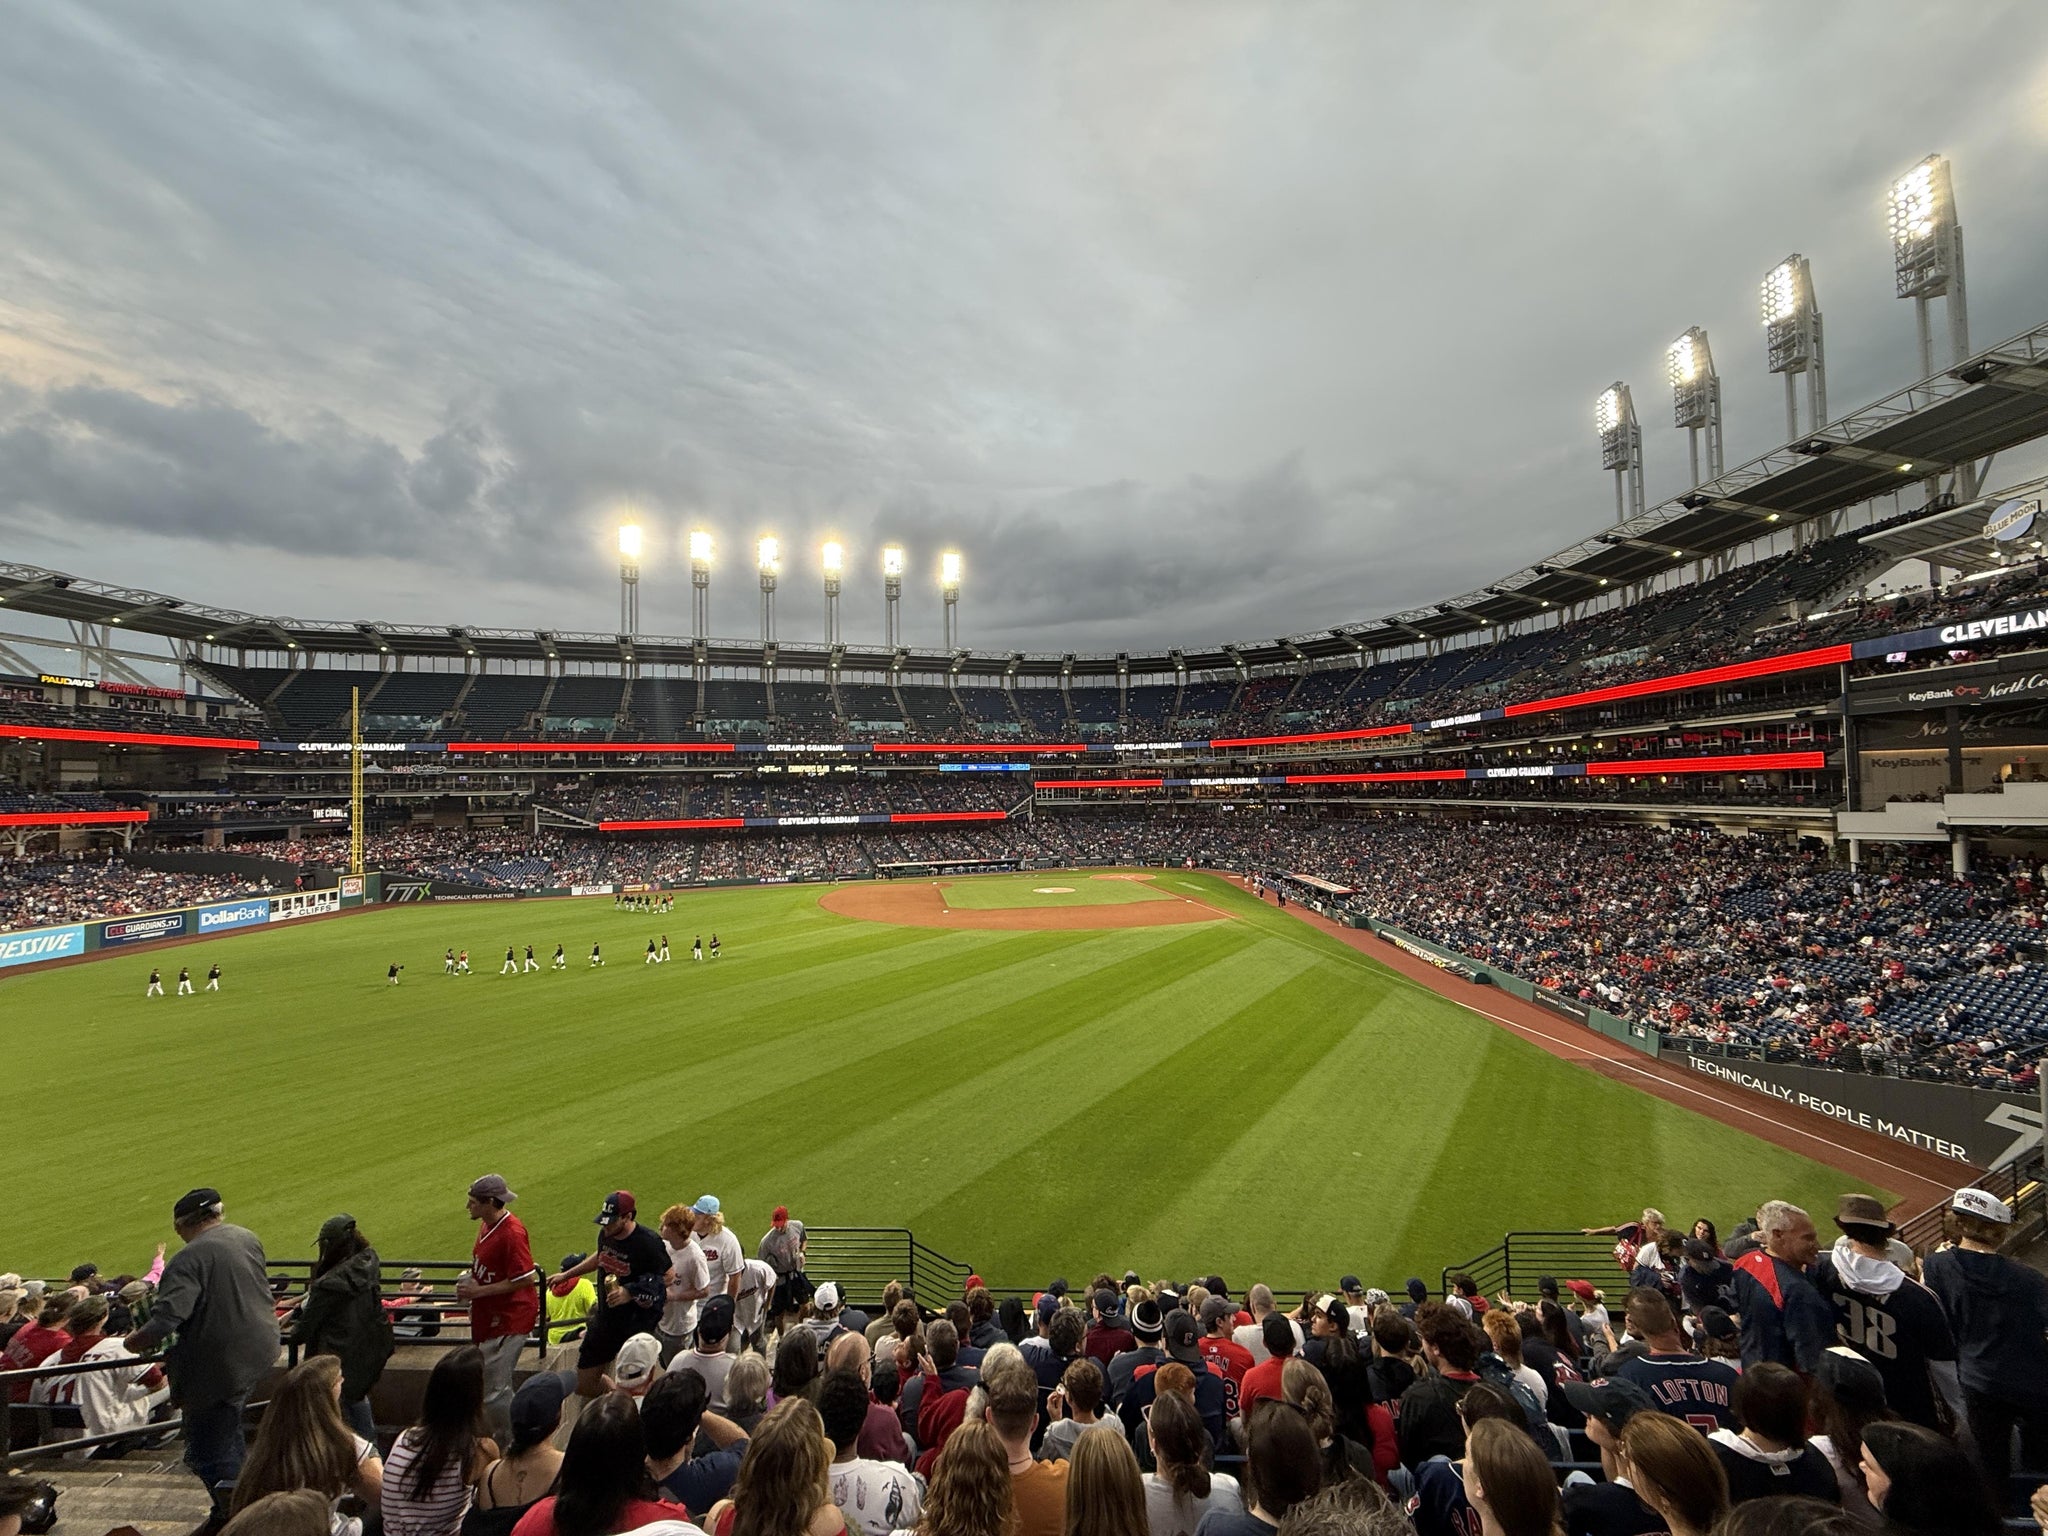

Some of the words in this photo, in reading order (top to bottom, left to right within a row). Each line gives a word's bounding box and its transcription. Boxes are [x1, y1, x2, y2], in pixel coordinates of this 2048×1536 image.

[1983, 517, 2009, 538] BLUE
[2010, 502, 2037, 523] MOON
[99, 680, 145, 695] PENNANT
[146, 686, 186, 699] DISTRICT
[1908, 688, 1954, 702] KeyBank
[1431, 716, 1454, 728] CLEVELAND
[1454, 712, 1481, 725] GUARDIANS
[298, 743, 352, 751] CLEVELAND
[353, 743, 406, 751] GUARDIANS
[767, 744, 805, 752] CLEVELAND
[1113, 743, 1147, 751] CLEVELAND
[1148, 741, 1182, 750] GUARDIANS
[1871, 757, 1942, 769] KeyBank
[1486, 767, 1518, 778] CLEVELAND
[1518, 766, 1554, 777] GUARDIANS
[1190, 778, 1224, 786] CLEVELAND
[1225, 777, 1259, 785] GUARDIANS
[312, 809, 324, 819] THE
[778, 817, 819, 826] CLEVELAND
[820, 816, 860, 825] GUARDIANS
[343, 879, 359, 888] drug
[200, 905, 268, 927] DollarBank
[299, 904, 332, 916] CLIFFS
[1687, 1055, 1794, 1103] TECHNICALLY,
[1799, 1092, 1872, 1129] PEOPLE
[1877, 1118, 1971, 1163] MATTER.
[1831, 1292, 1898, 1360] 38
[1651, 1378, 1729, 1407] LOFTON
